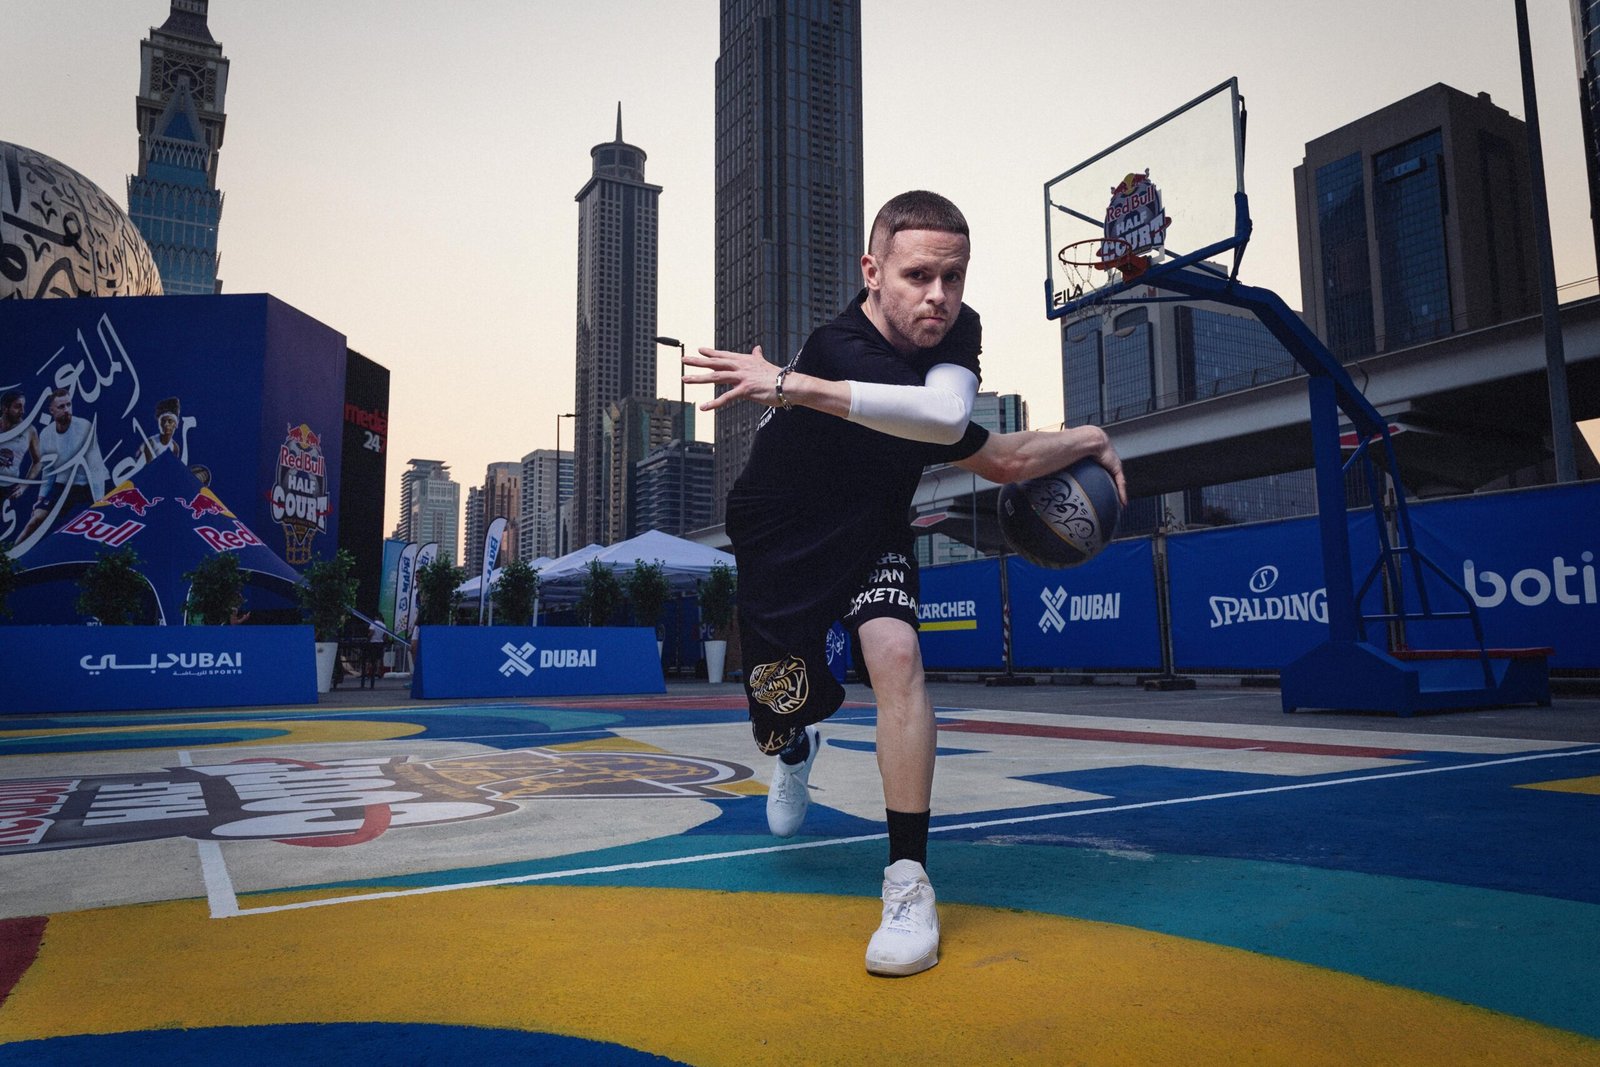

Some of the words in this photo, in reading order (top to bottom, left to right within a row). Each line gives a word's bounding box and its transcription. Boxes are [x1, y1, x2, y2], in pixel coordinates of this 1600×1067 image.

[1106, 197, 1130, 222] Red
[1131, 185, 1156, 211] Bull
[1103, 212, 1164, 261] COURT
[1116, 211, 1148, 236] HALF
[1053, 284, 1083, 306] FILA
[280, 446, 303, 471] Red
[303, 454, 325, 477] Bull
[288, 475, 316, 494] HALF
[272, 485, 328, 532] COURT
[65, 511, 145, 547] Bull
[194, 520, 262, 552] Red
[1463, 550, 1597, 608] boti
[1070, 592, 1121, 621] DUBAI
[1209, 587, 1329, 628] SPALDING
[540, 649, 597, 668] DUBAI
[82, 781, 209, 826] HALF
[186, 757, 496, 837] COURT
